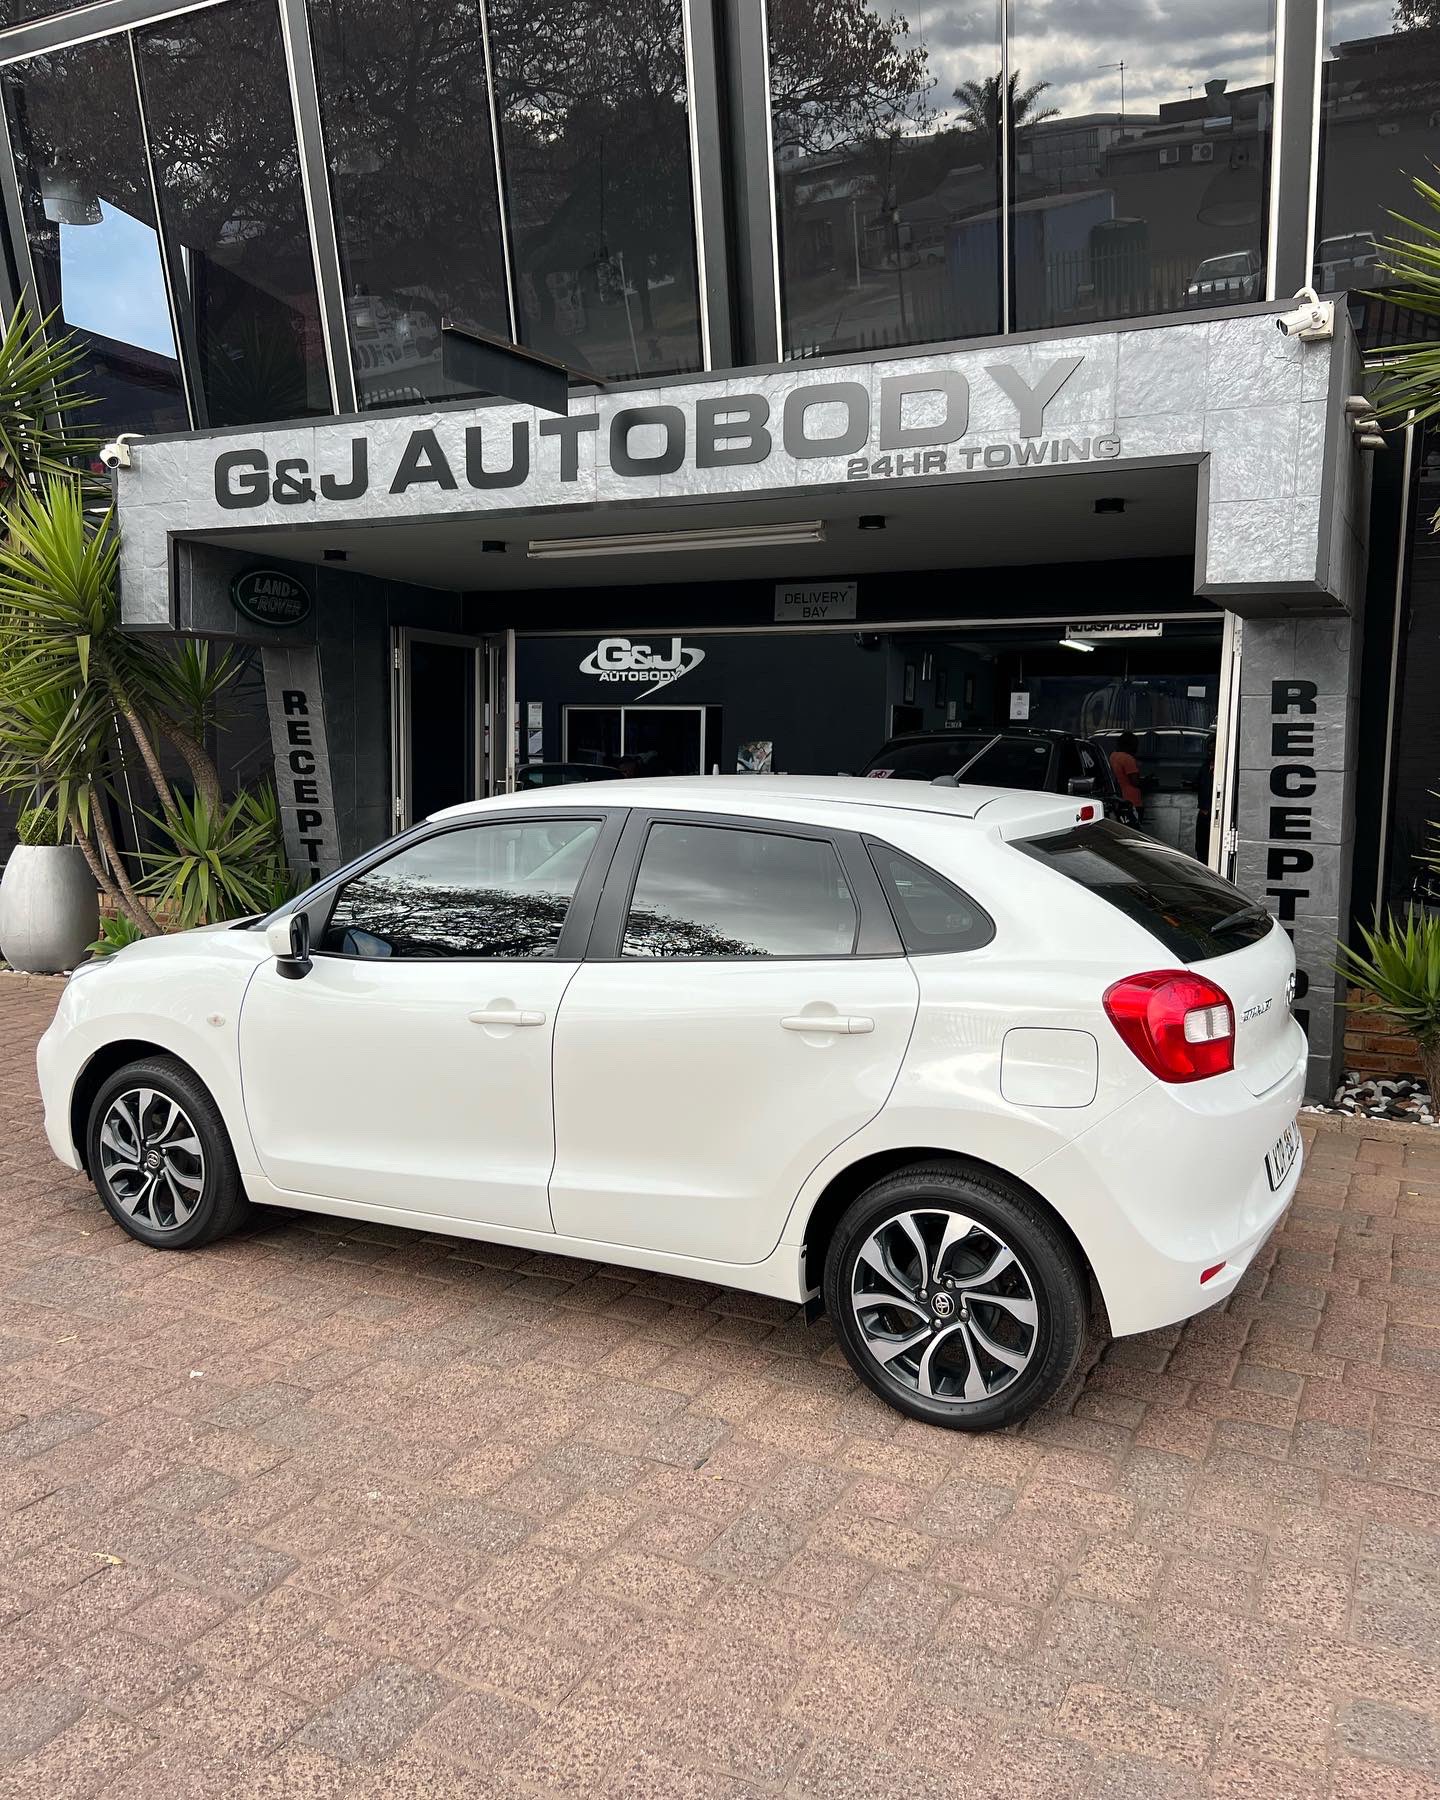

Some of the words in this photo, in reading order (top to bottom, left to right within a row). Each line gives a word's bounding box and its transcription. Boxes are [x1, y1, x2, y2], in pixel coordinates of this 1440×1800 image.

[214, 437, 368, 510] G&J
[389, 356, 1085, 494] AUTOBODY
[847, 450, 947, 481] 24HR
[959, 433, 1121, 472] TOWING
[254, 578, 290, 597] LAND
[784, 591, 848, 604] DELIVERY
[803, 606, 828, 618] BAY
[597, 637, 682, 671] G&J
[599, 669, 681, 682] AUTOBODY
[1265, 680, 1317, 1040] RECEPT
